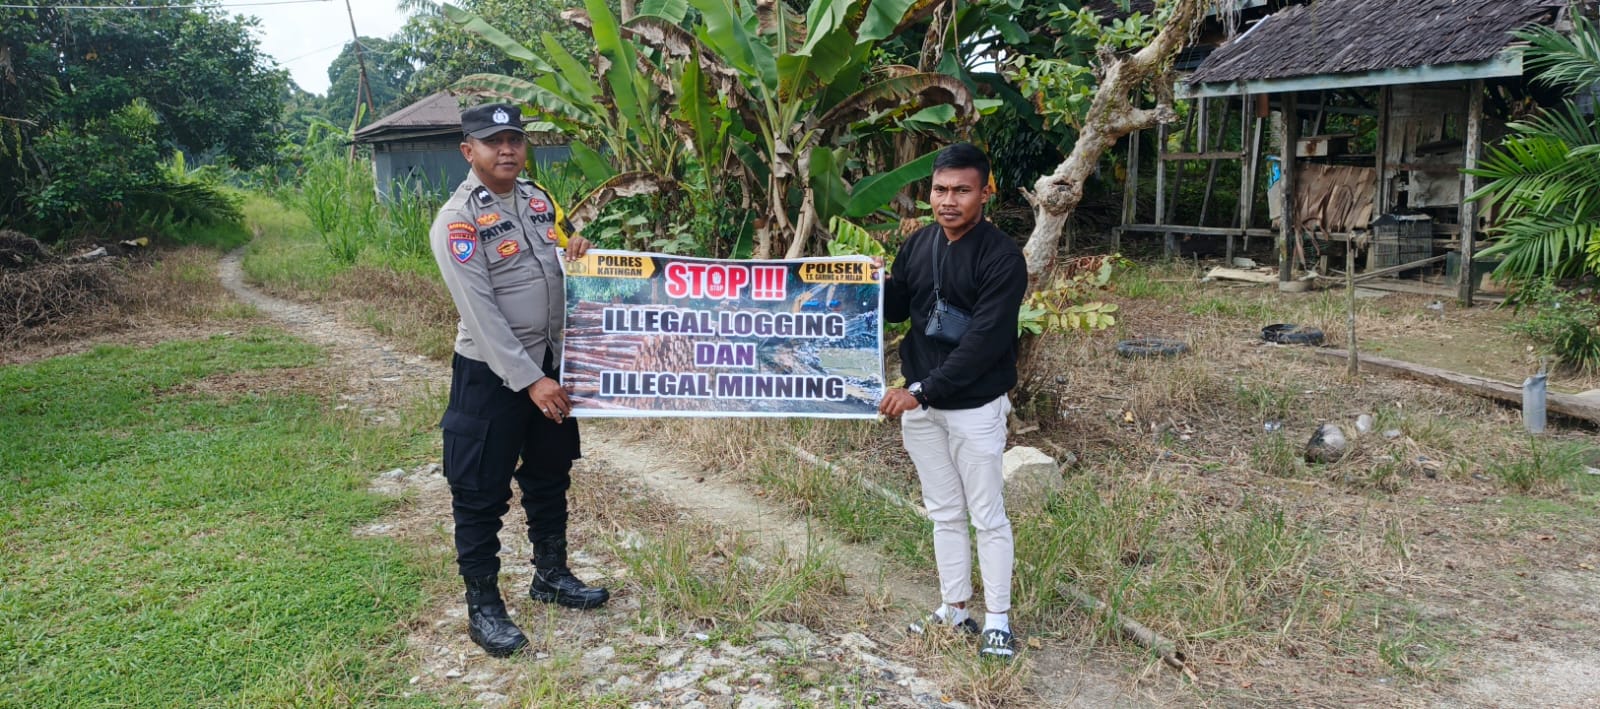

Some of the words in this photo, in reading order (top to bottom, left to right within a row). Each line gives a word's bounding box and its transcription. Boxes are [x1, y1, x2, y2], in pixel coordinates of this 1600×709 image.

[597, 255, 642, 268] POLRES
[597, 267, 642, 276] KATINGAN
[805, 263, 863, 274] POLSEK
[666, 262, 749, 299] STOP
[604, 308, 714, 335] ILLEGAL
[719, 311, 845, 338] LOGGING
[695, 342, 755, 366] DAN
[600, 371, 712, 397] ILLEGAL
[717, 374, 844, 400] MINNING
